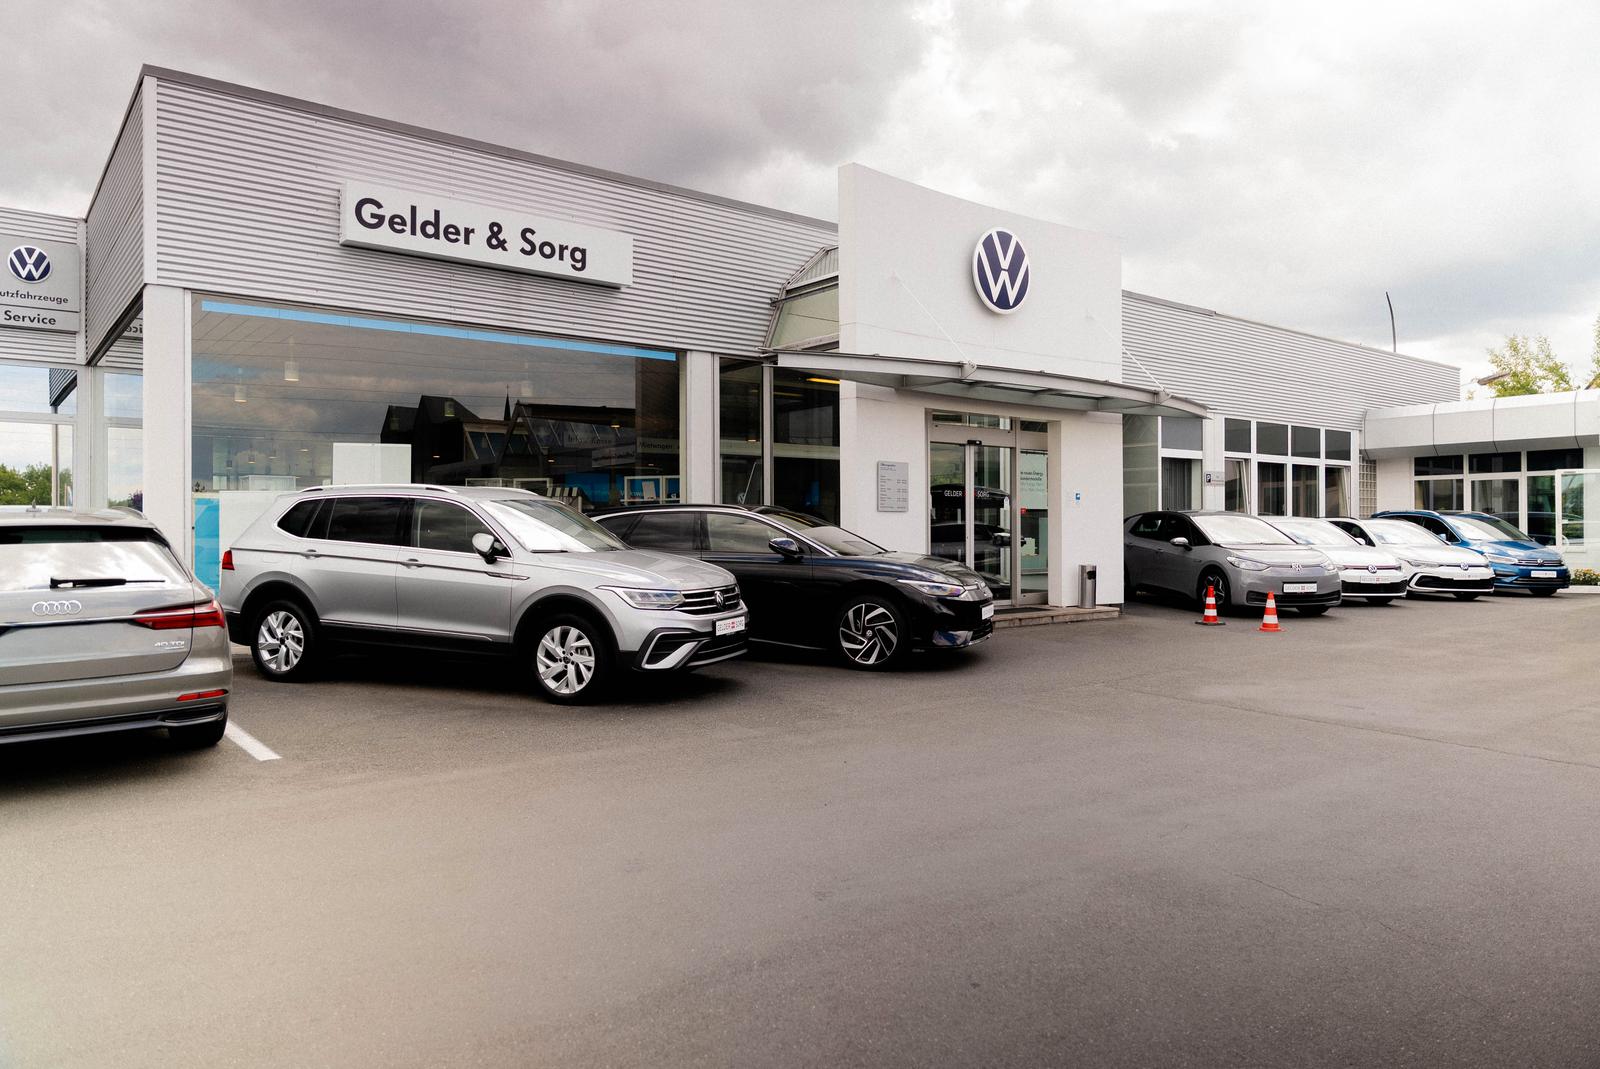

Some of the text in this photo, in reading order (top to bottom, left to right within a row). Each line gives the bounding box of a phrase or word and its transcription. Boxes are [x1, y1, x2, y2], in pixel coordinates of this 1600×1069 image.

[354, 197, 588, 272] Gelder & Sorg
[4, 310, 56, 325] Service
